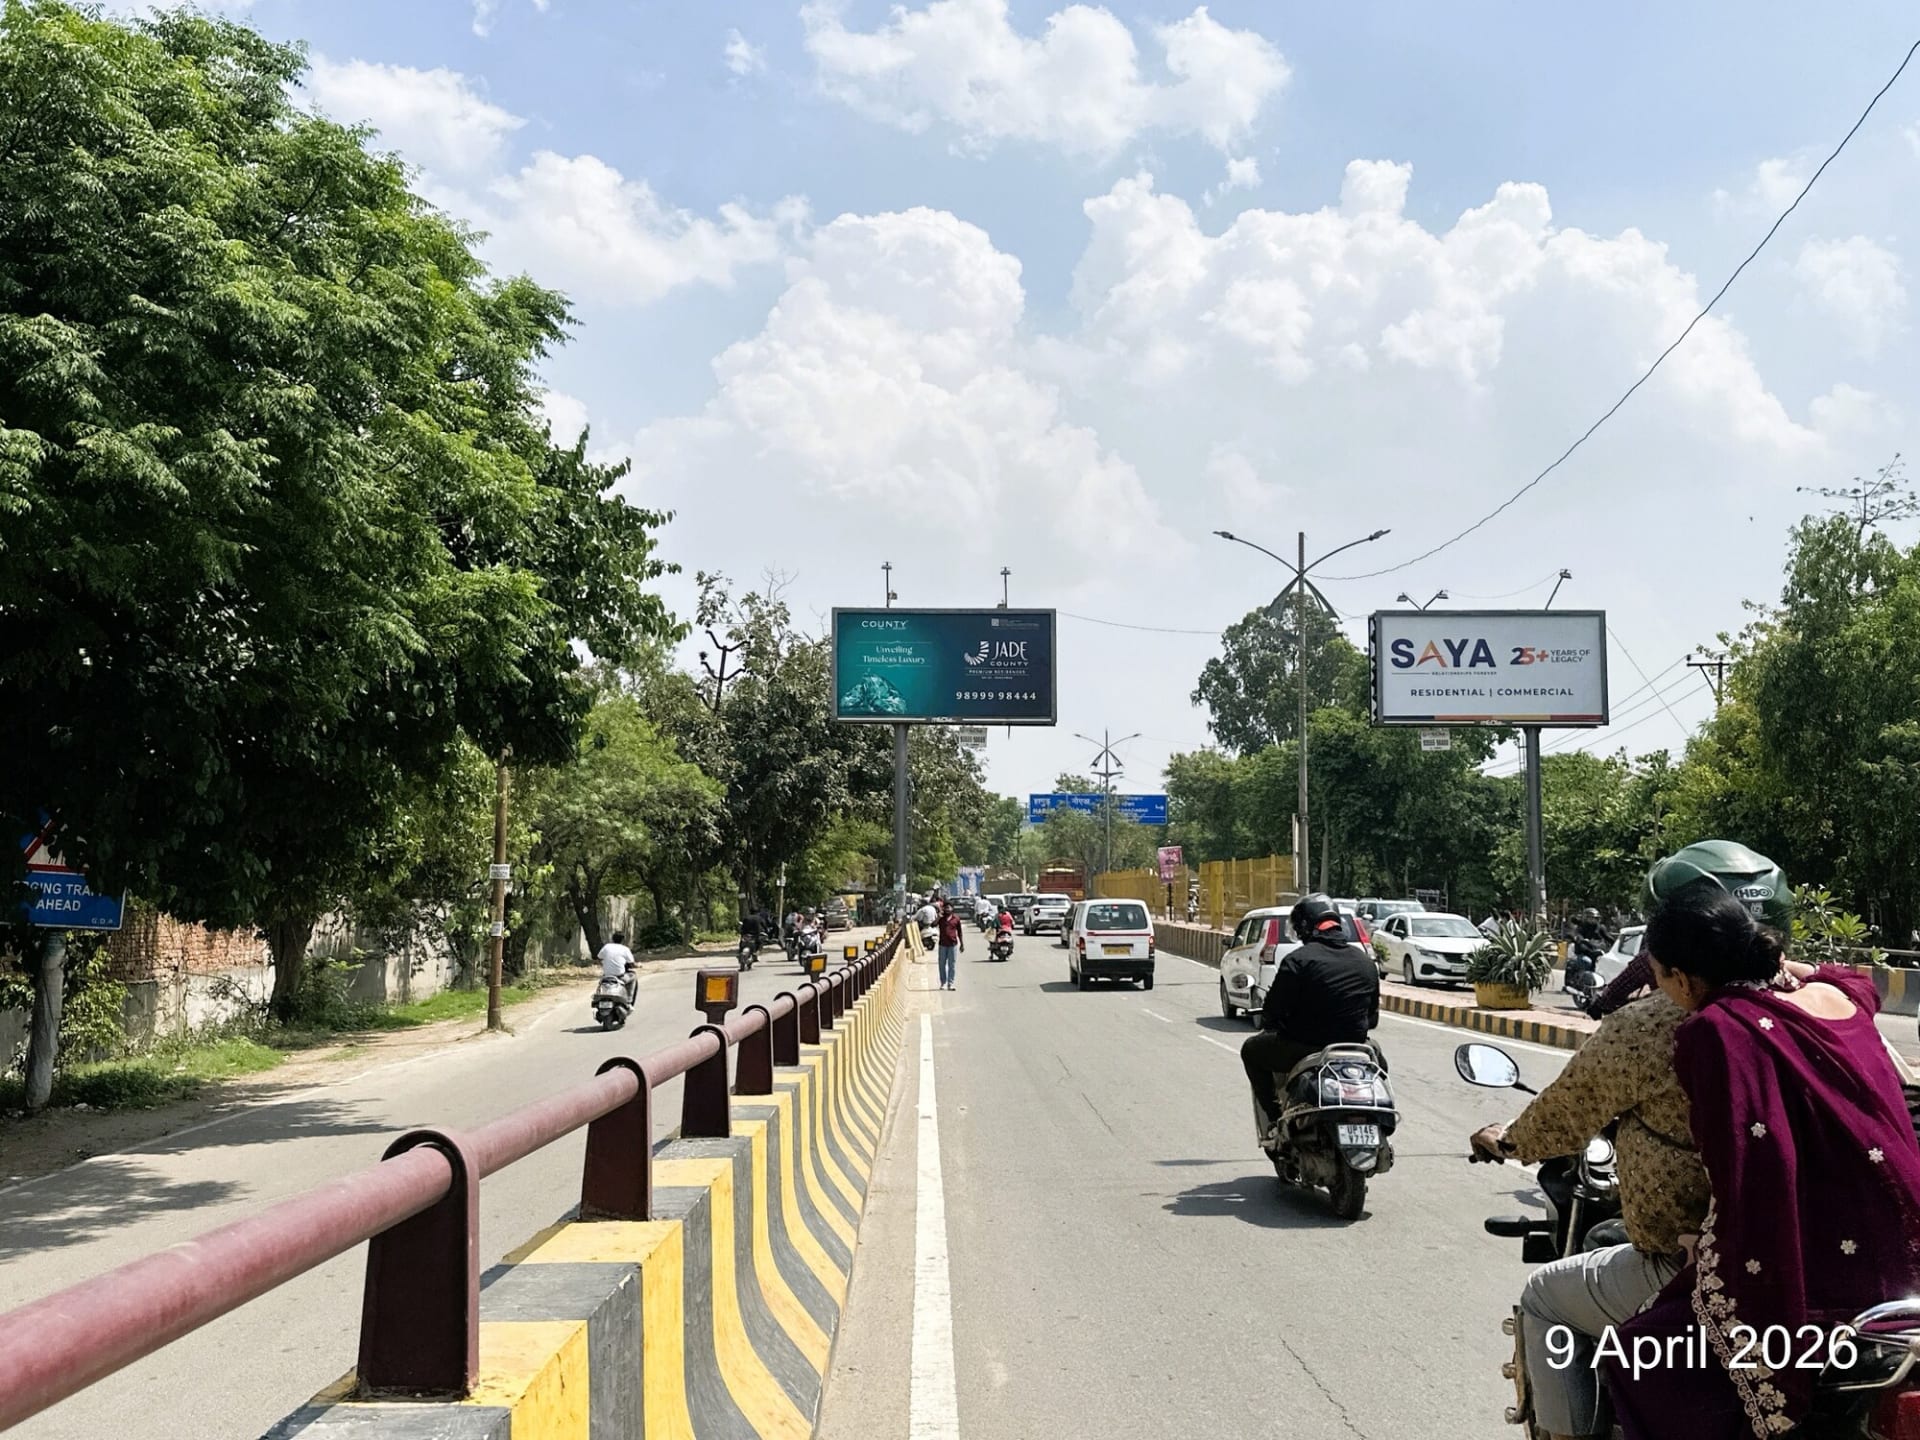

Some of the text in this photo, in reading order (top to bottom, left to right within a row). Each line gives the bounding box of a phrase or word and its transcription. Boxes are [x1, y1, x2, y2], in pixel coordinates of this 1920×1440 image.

[861, 620, 906, 628] COUNTY
[875, 645, 913, 655] Unveiling
[991, 641, 1028, 660] JADE
[1390, 638, 1497, 668] SAYA
[863, 655, 925, 664] Timeless Luxury
[1510, 647, 1549, 665] 25+
[955, 691, 1036, 700] 98999 98444
[1410, 688, 1485, 697] RESIDENTIAL
[1497, 688, 1574, 697] COMMERCIAL
[35, 899, 81, 911] AHEAD
